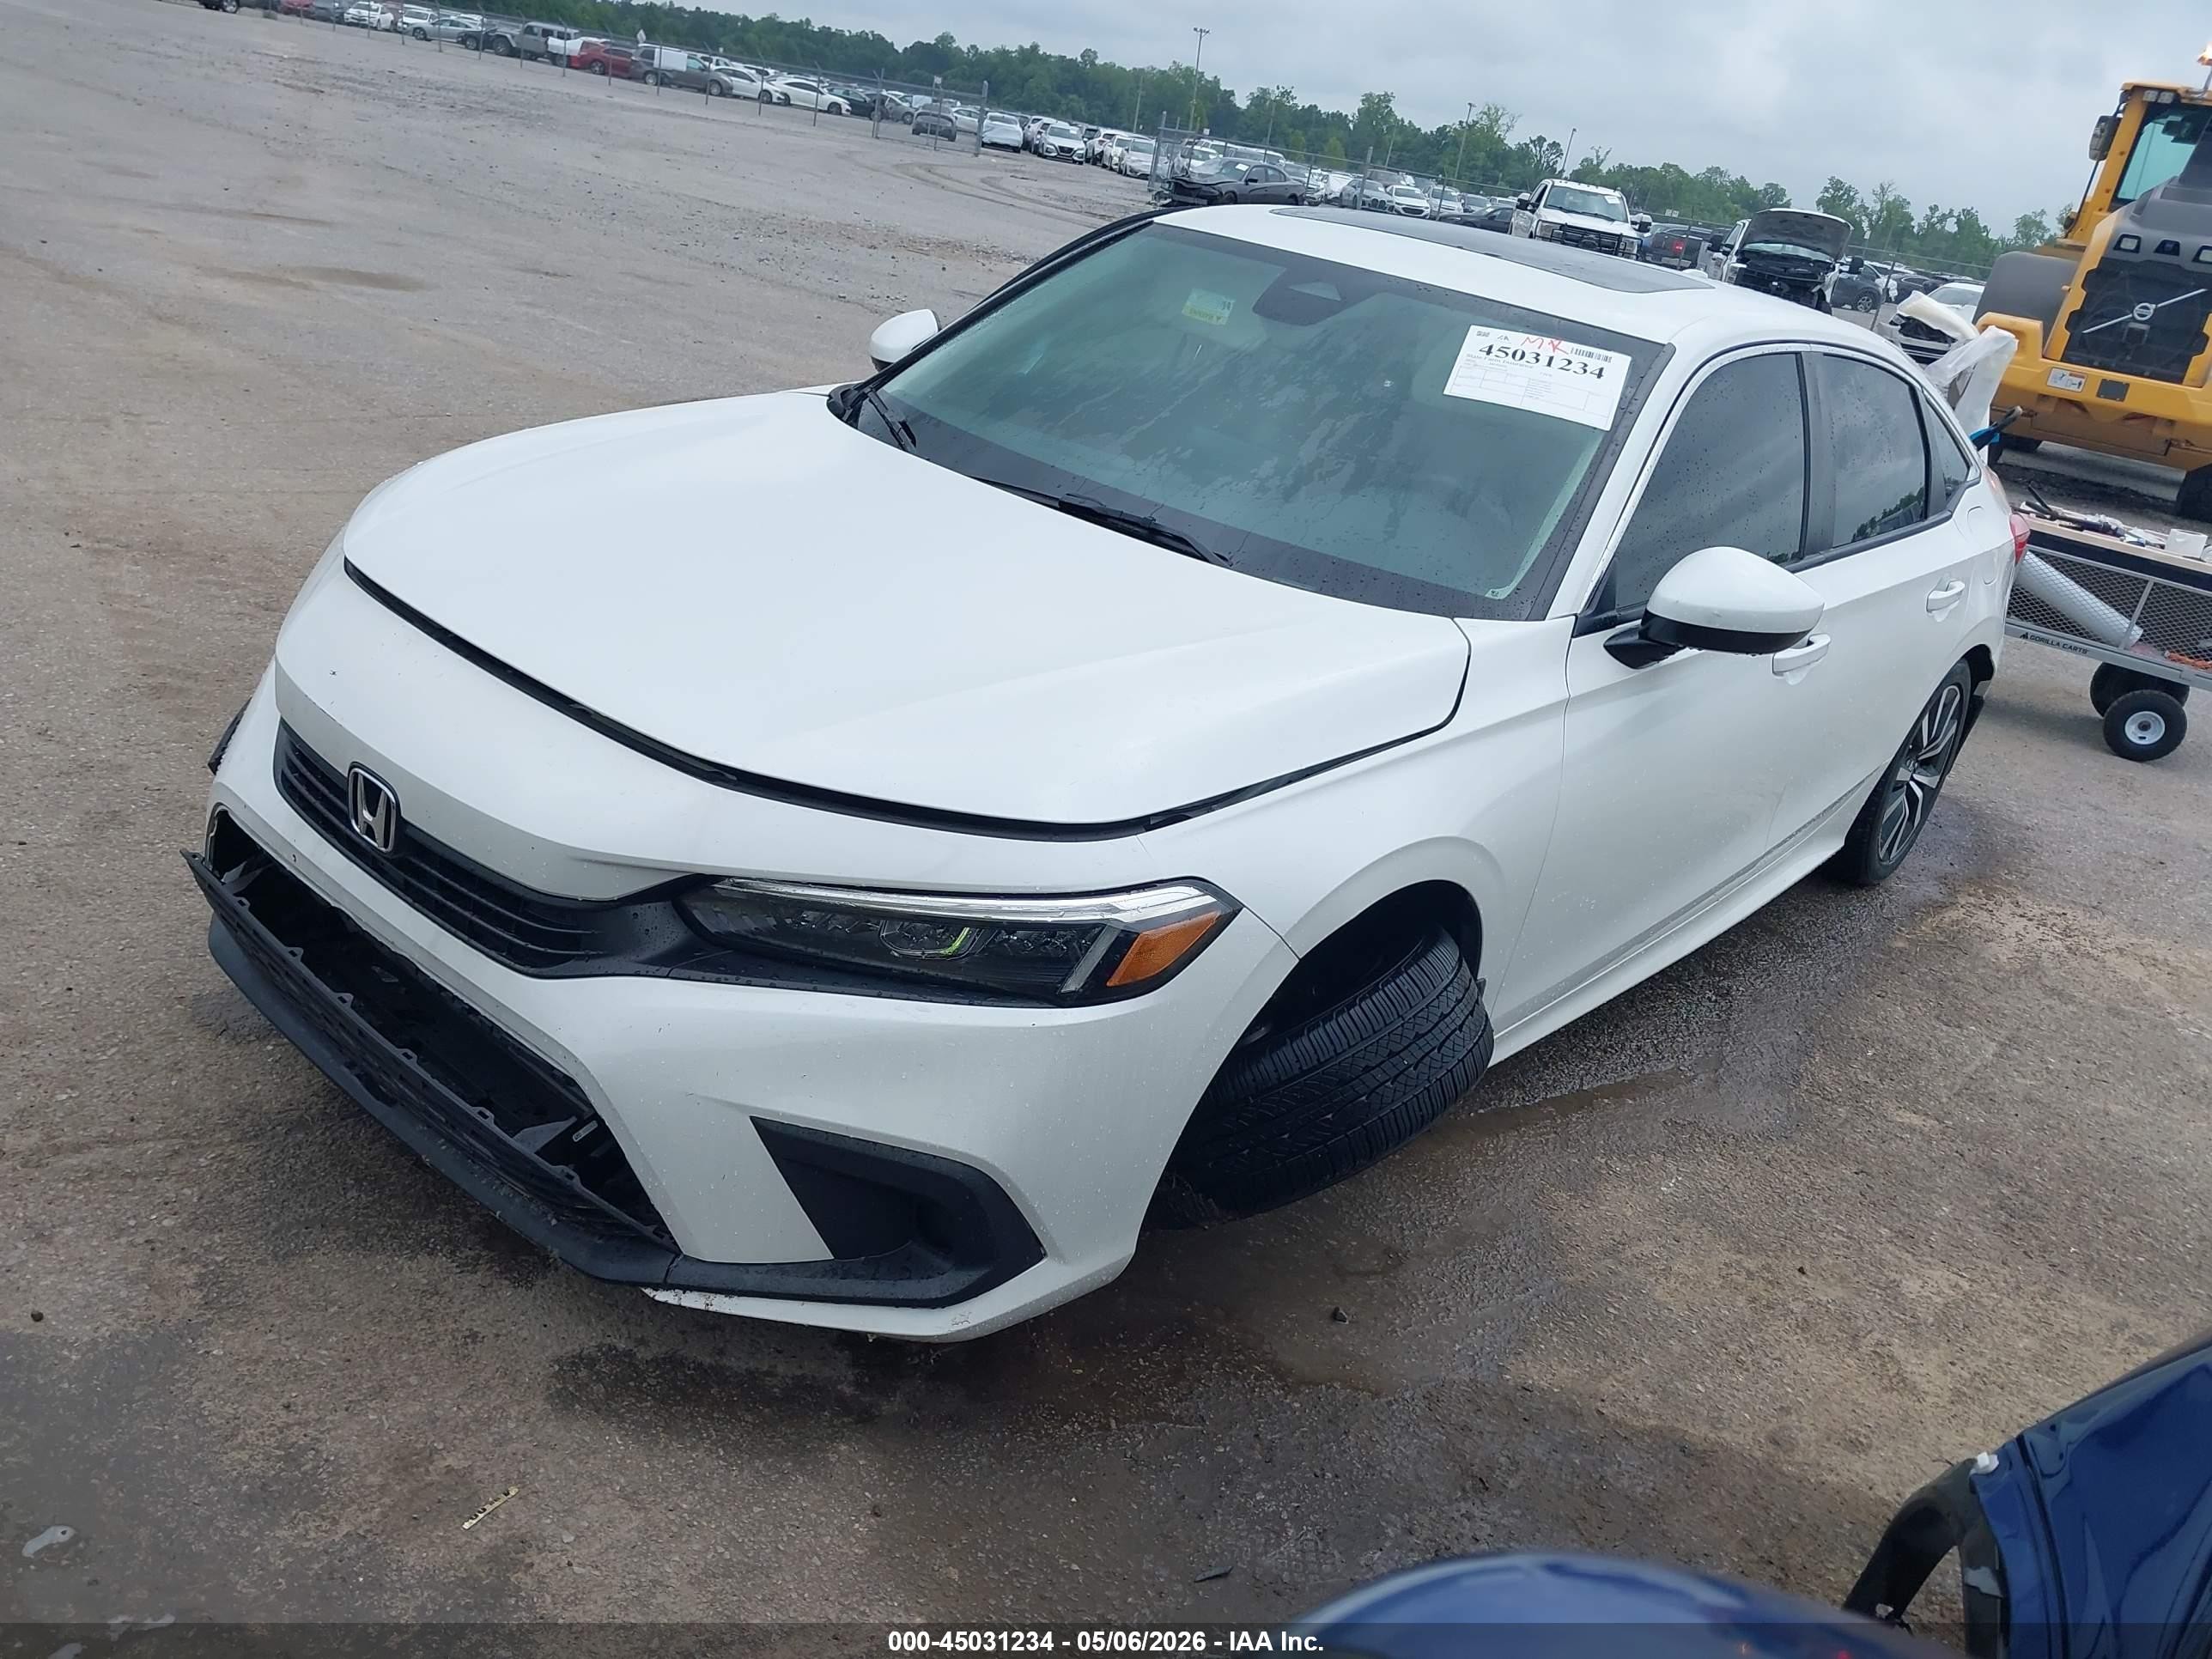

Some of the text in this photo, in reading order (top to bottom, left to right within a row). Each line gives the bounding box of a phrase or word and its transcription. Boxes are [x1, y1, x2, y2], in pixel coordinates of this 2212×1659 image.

[1478, 343, 1604, 380] 45031234
[2029, 635, 2088, 654] GORILLA CARTS
